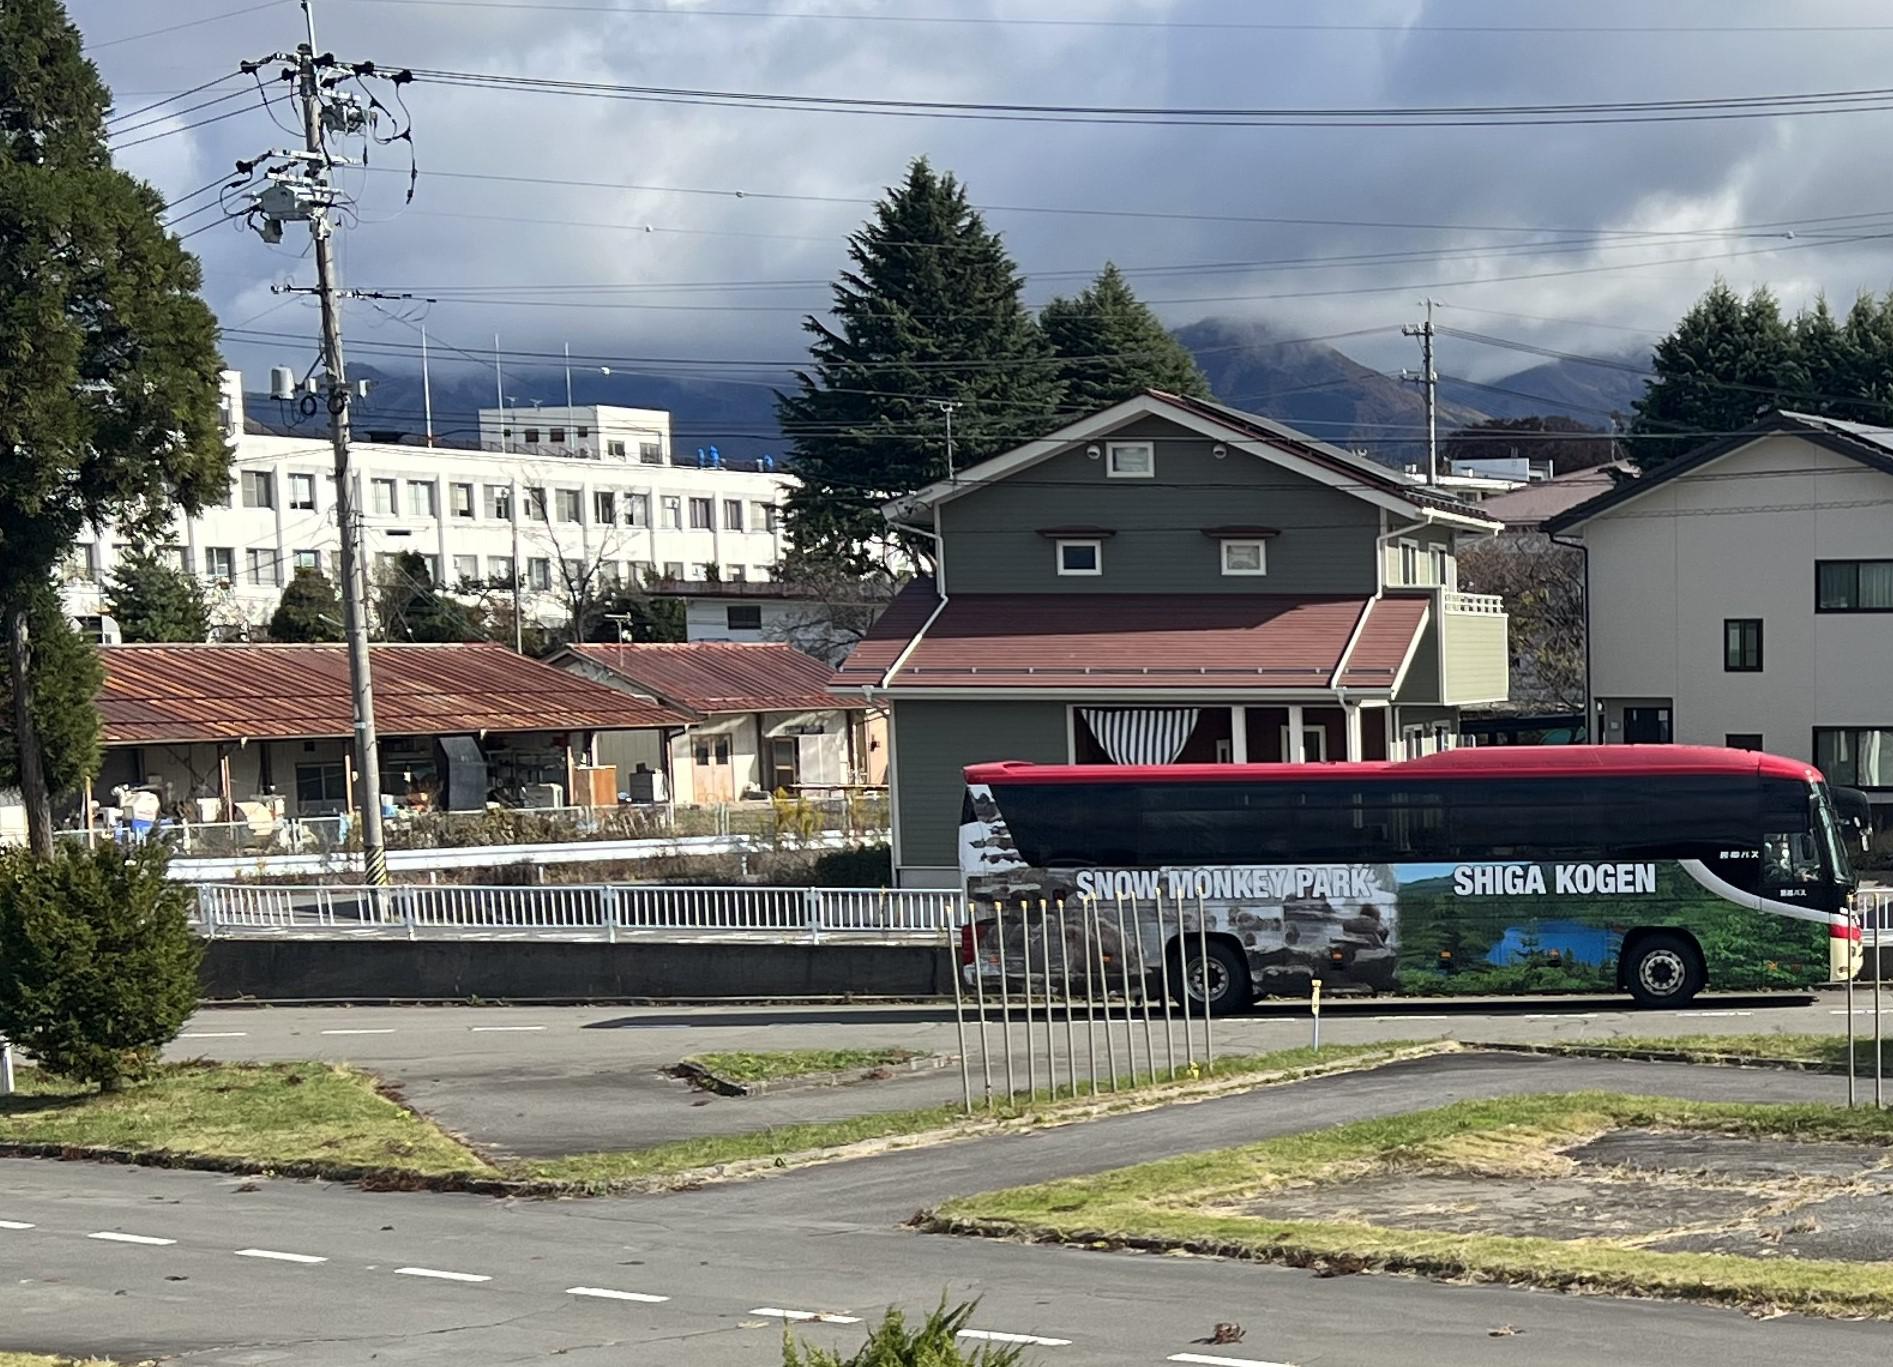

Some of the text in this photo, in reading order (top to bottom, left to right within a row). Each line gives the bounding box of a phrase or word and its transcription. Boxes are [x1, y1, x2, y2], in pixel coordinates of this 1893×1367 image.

[1076, 868, 1372, 901] SNOW MONKEY PARK
[1453, 863, 1656, 896] SHIGA KOGEN
